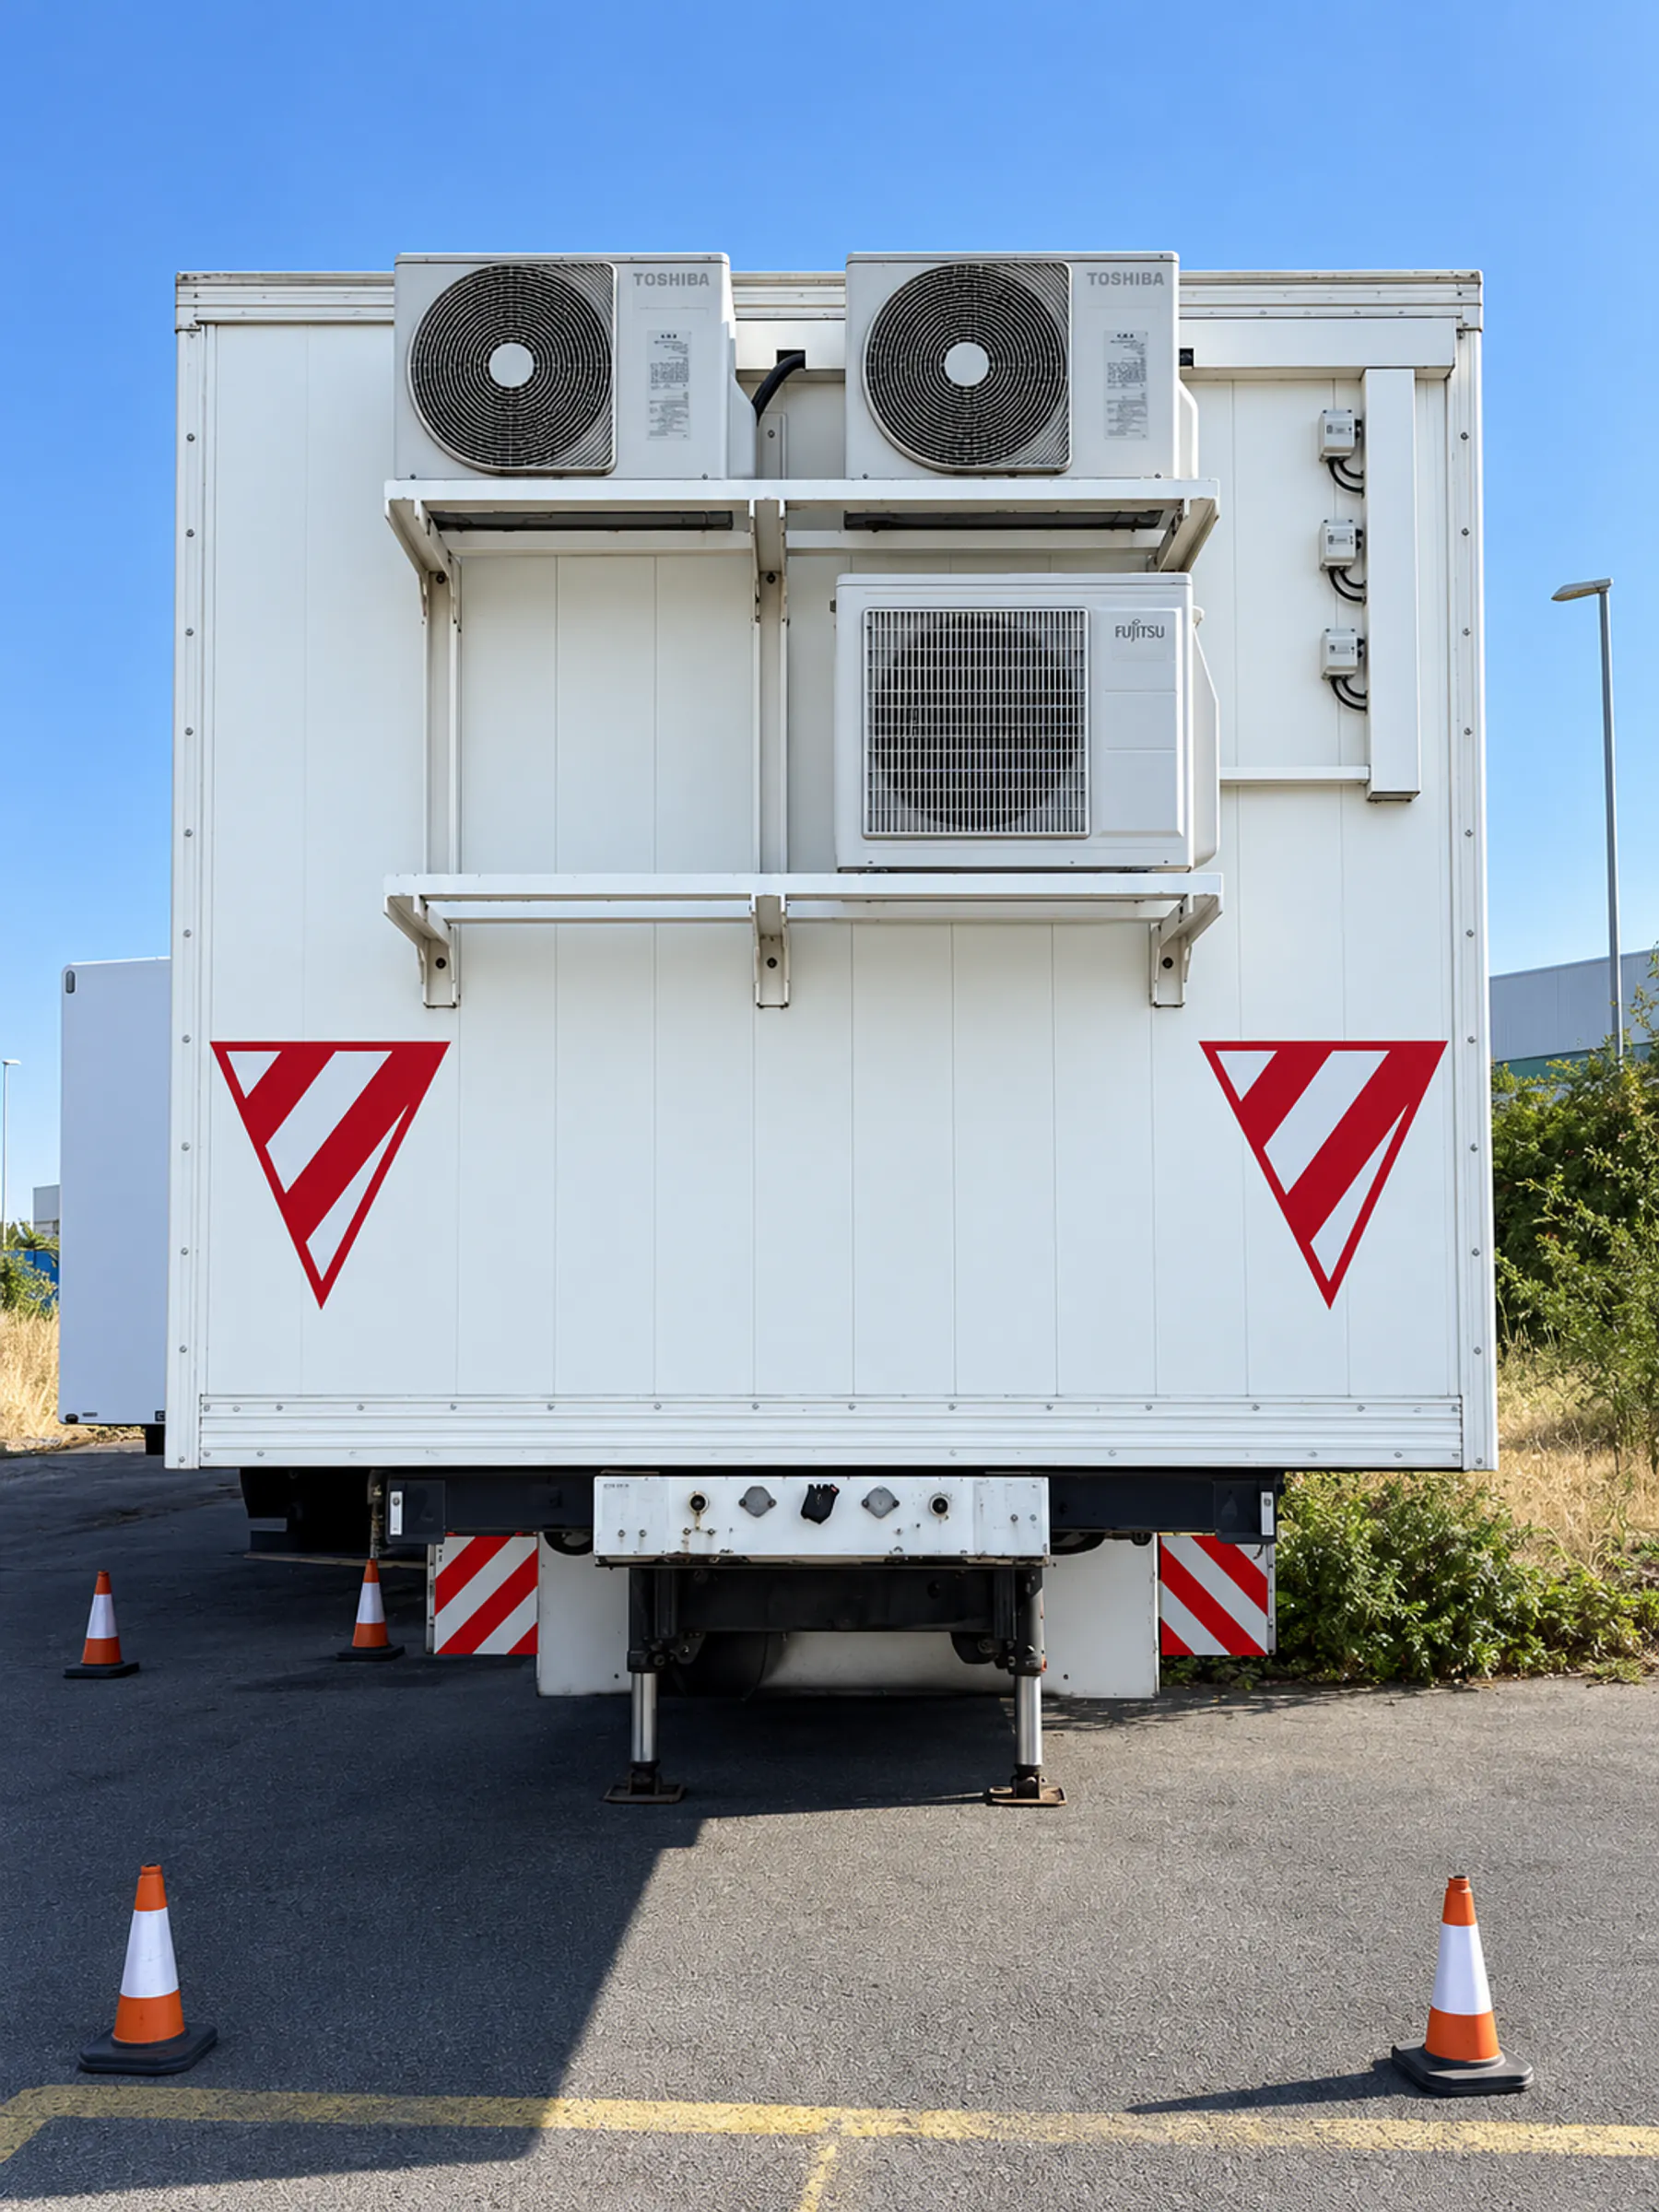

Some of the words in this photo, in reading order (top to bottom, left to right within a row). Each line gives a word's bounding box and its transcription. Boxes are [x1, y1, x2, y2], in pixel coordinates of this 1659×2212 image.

[633, 273, 710, 287] TOSHIBA
[1087, 272, 1165, 286] TOSHIBA
[1114, 618, 1165, 642] FUJITSU
